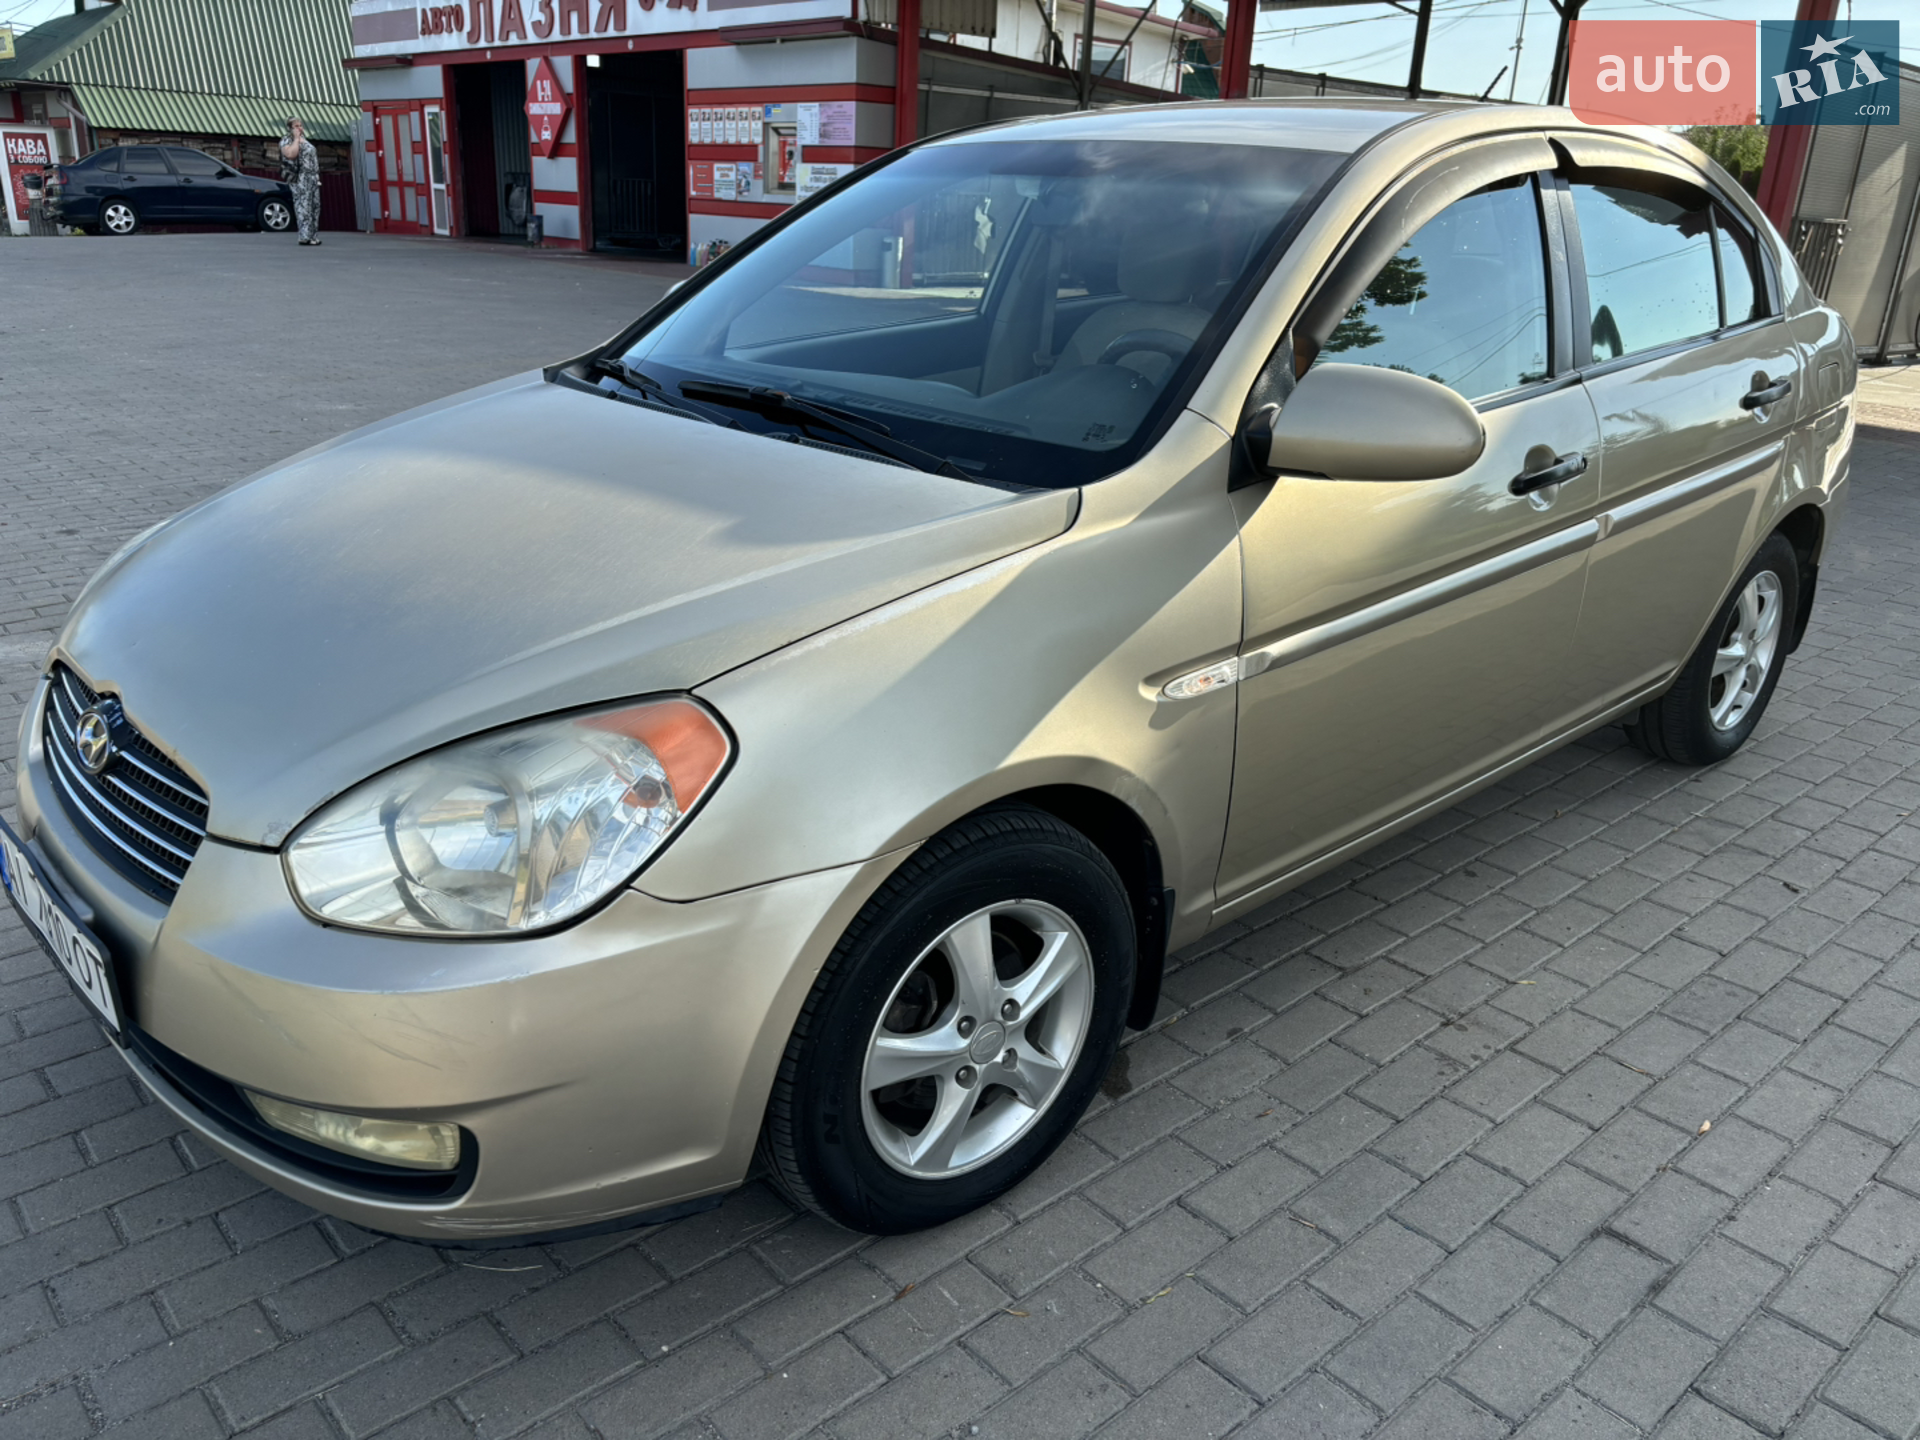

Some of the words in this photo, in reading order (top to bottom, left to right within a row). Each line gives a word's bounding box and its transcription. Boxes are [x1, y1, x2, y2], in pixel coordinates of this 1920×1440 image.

[420, 5, 465, 37] АВТО
[467, 0, 627, 45] ЛАЗНЯ
[6, 138, 47, 156] КАВА
[18, 155, 48, 165] СОБОЮ
